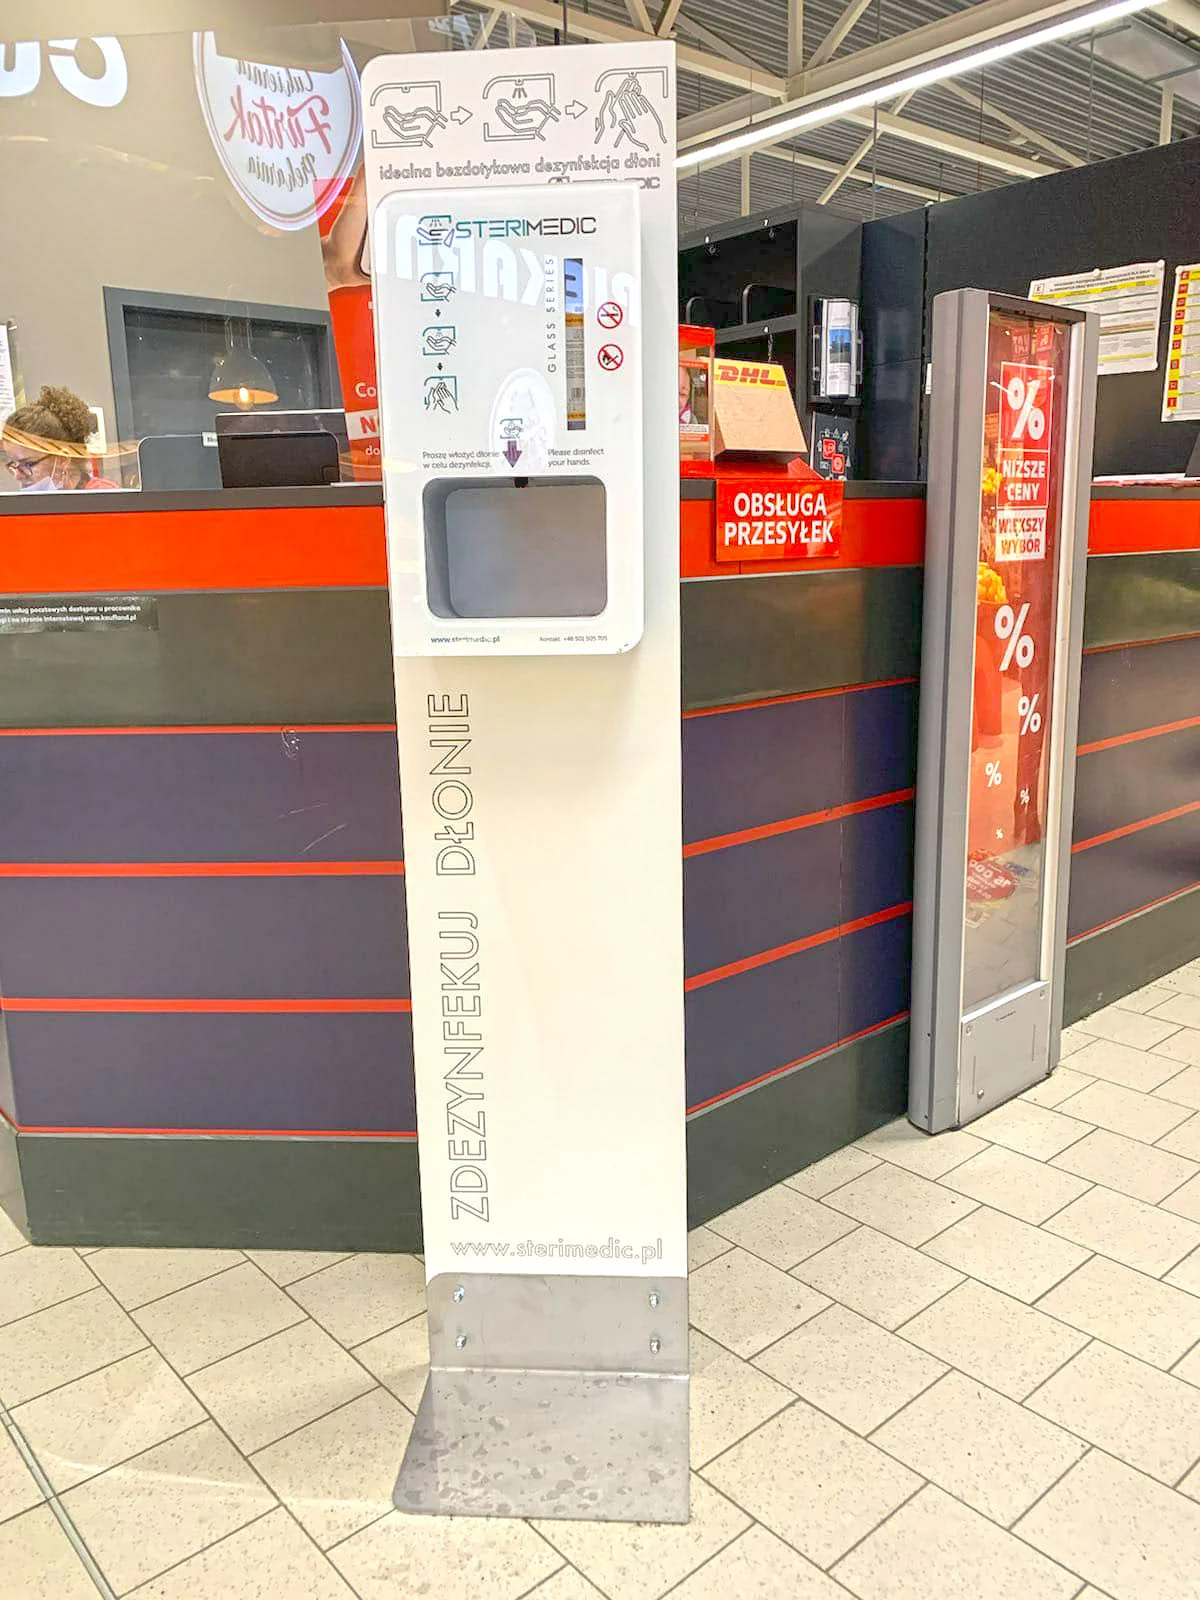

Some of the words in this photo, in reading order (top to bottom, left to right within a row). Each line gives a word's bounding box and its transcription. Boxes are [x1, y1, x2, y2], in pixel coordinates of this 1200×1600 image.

[379, 162, 432, 180] idealna
[435, 158, 530, 180] bezdotykowa
[534, 154, 620, 176] dezynfekcja
[623, 152, 661, 169] dłoni
[456, 216, 597, 239] STERIMEDIC
[545, 258, 556, 313] SERIES
[546, 322, 557, 373] GLASS
[718, 364, 776, 386] DHL
[422, 450, 447, 460] Proszę
[547, 448, 571, 456] Please
[572, 447, 605, 456] disinfect
[431, 461, 448, 469] celu
[547, 459, 565, 468] your
[1002, 456, 1046, 479] NIŻSZE
[1007, 482, 1040, 501] CENY
[733, 492, 828, 518] OBSŁUGA
[724, 519, 834, 547] PRZESYŁEK
[1001, 532, 1041, 555] WYBÓR
[427, 692, 476, 876] DŁONIE
[438, 911, 490, 1223] ZDEZYNFEKUJ
[450, 1236, 663, 1265] www.sterimedic.pl
